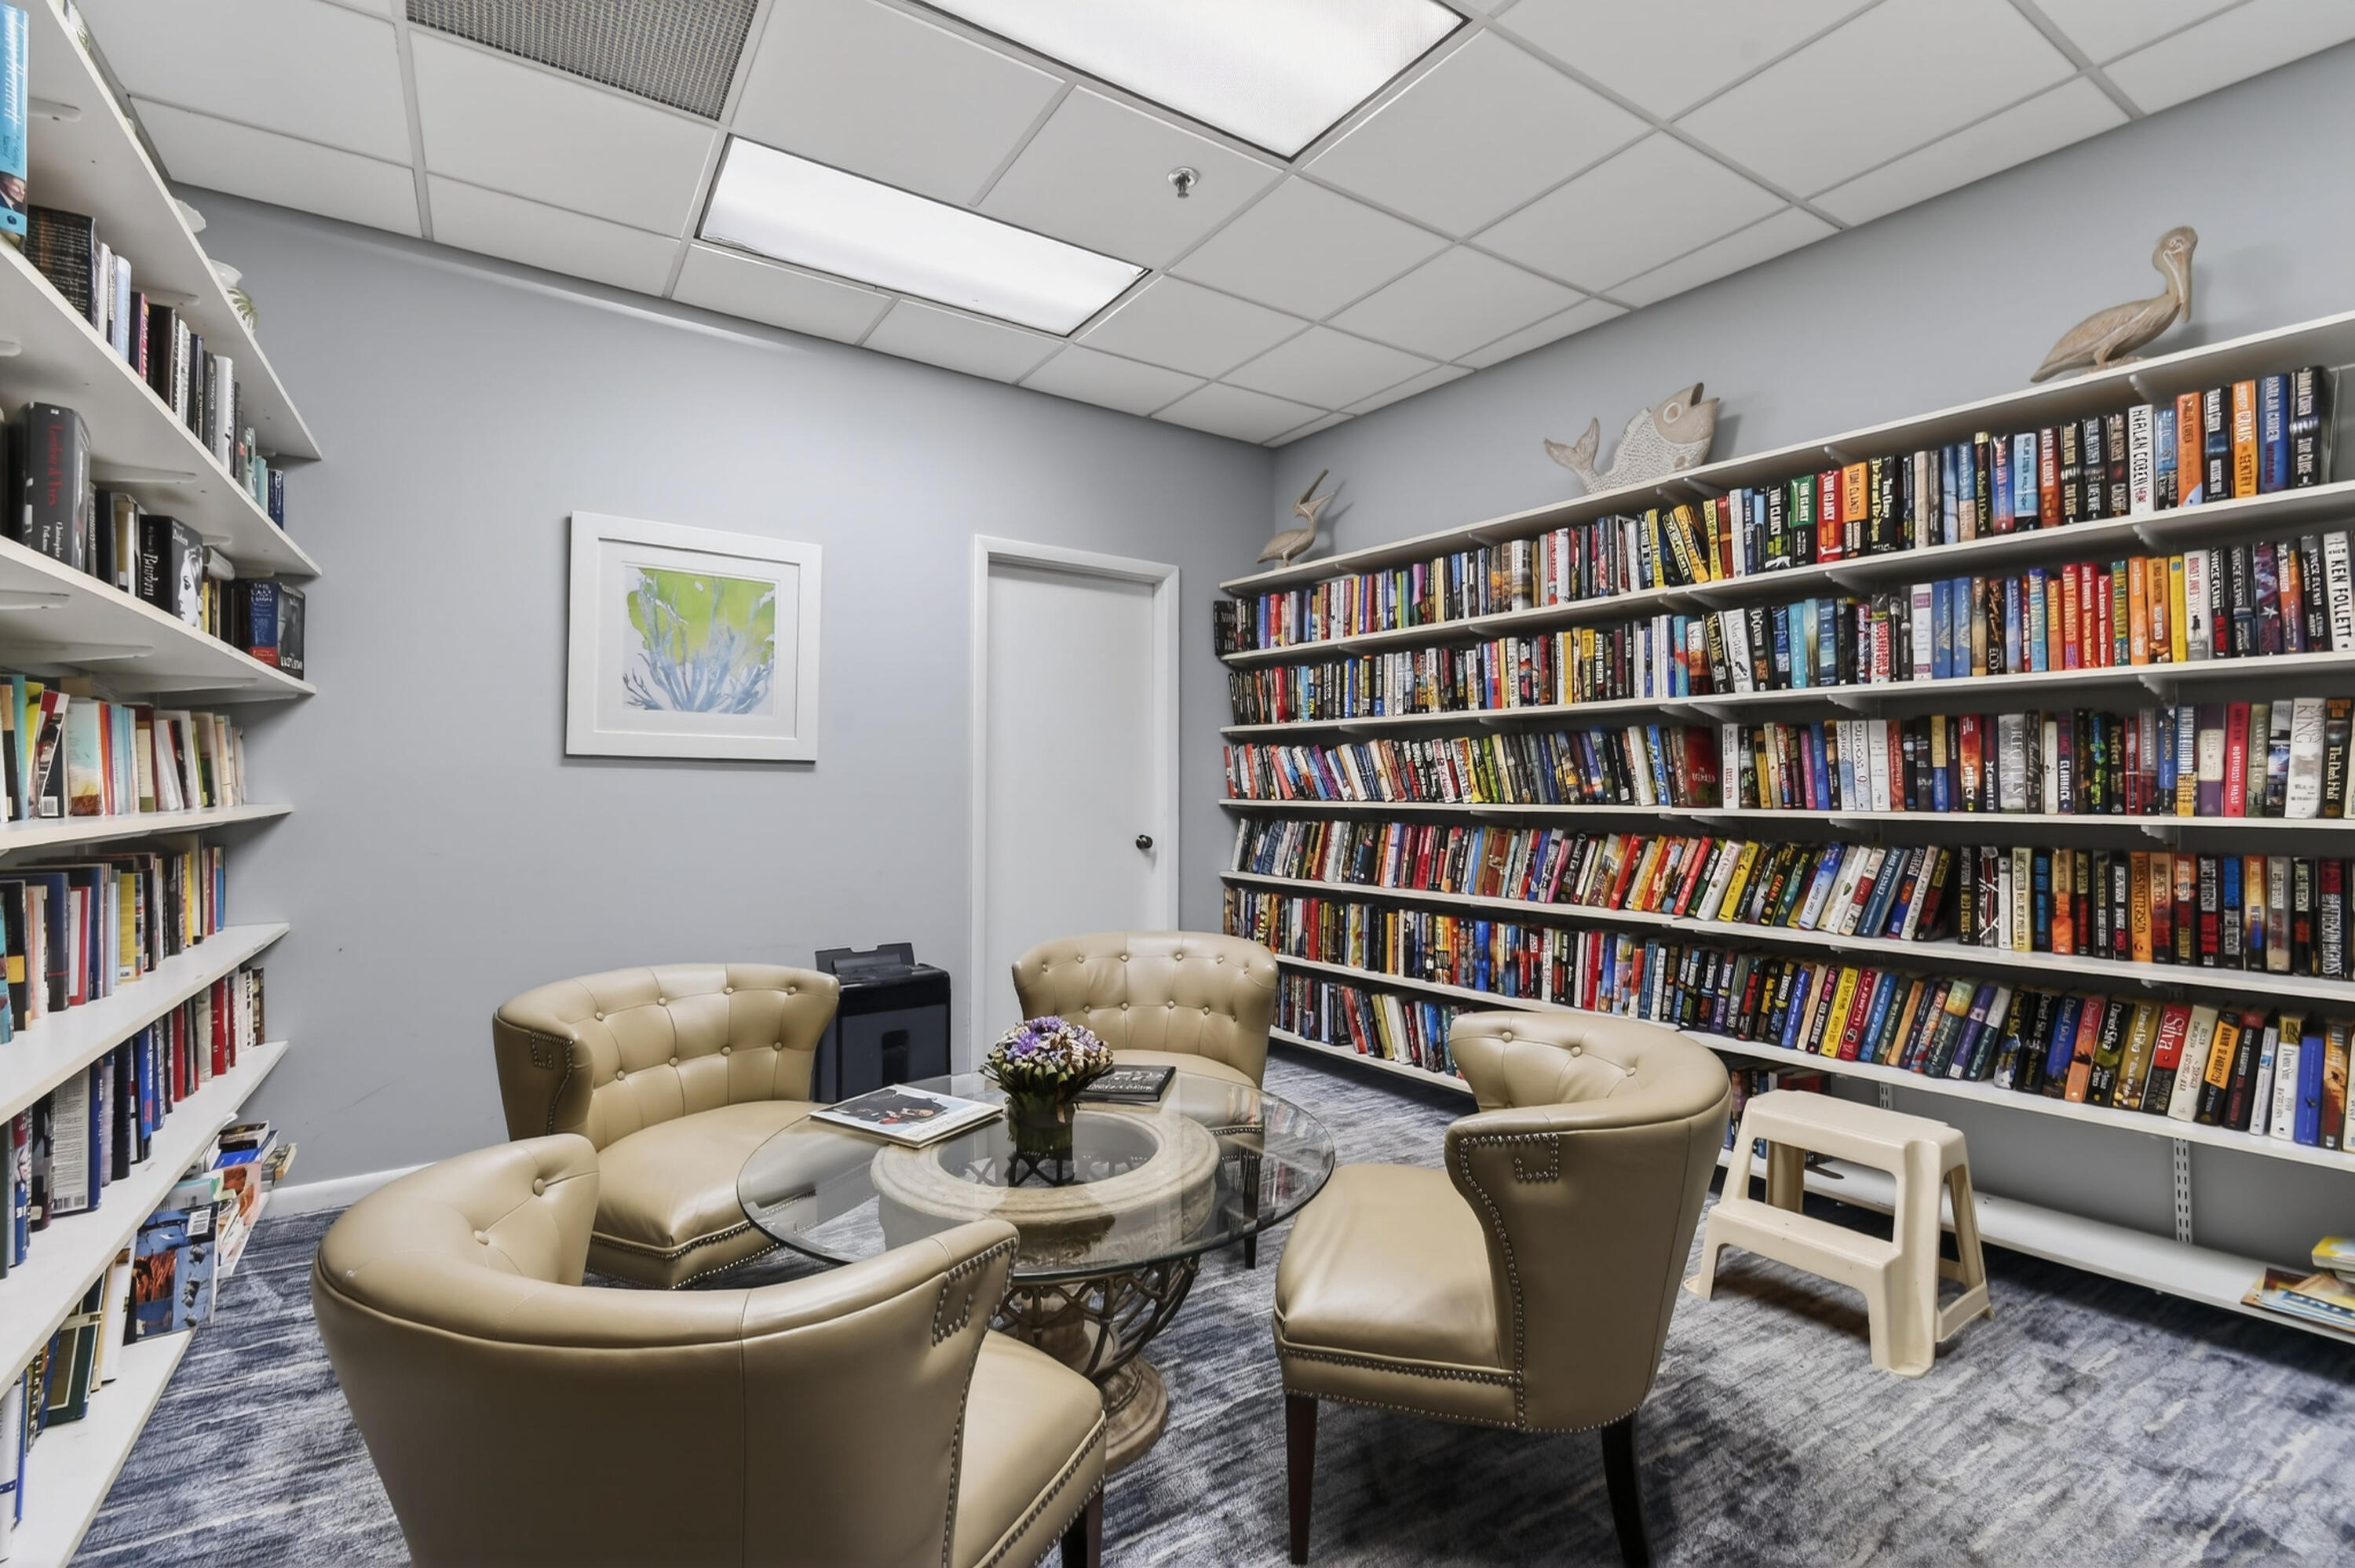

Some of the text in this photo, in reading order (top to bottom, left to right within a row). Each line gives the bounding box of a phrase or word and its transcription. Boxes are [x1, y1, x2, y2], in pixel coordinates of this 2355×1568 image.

[2132, 409, 2149, 487] HARLAN COBEN
[2331, 560, 2352, 638] KEN FOLLETT
[1988, 647, 1999, 670] ECO
[2293, 704, 2314, 744] KING
[2134, 883, 2148, 933] PATTERSON
[2101, 1003, 2123, 1051] Daniel Silva
[2138, 1005, 2152, 1032] Daniel
[2157, 1013, 2185, 1051] Silva
